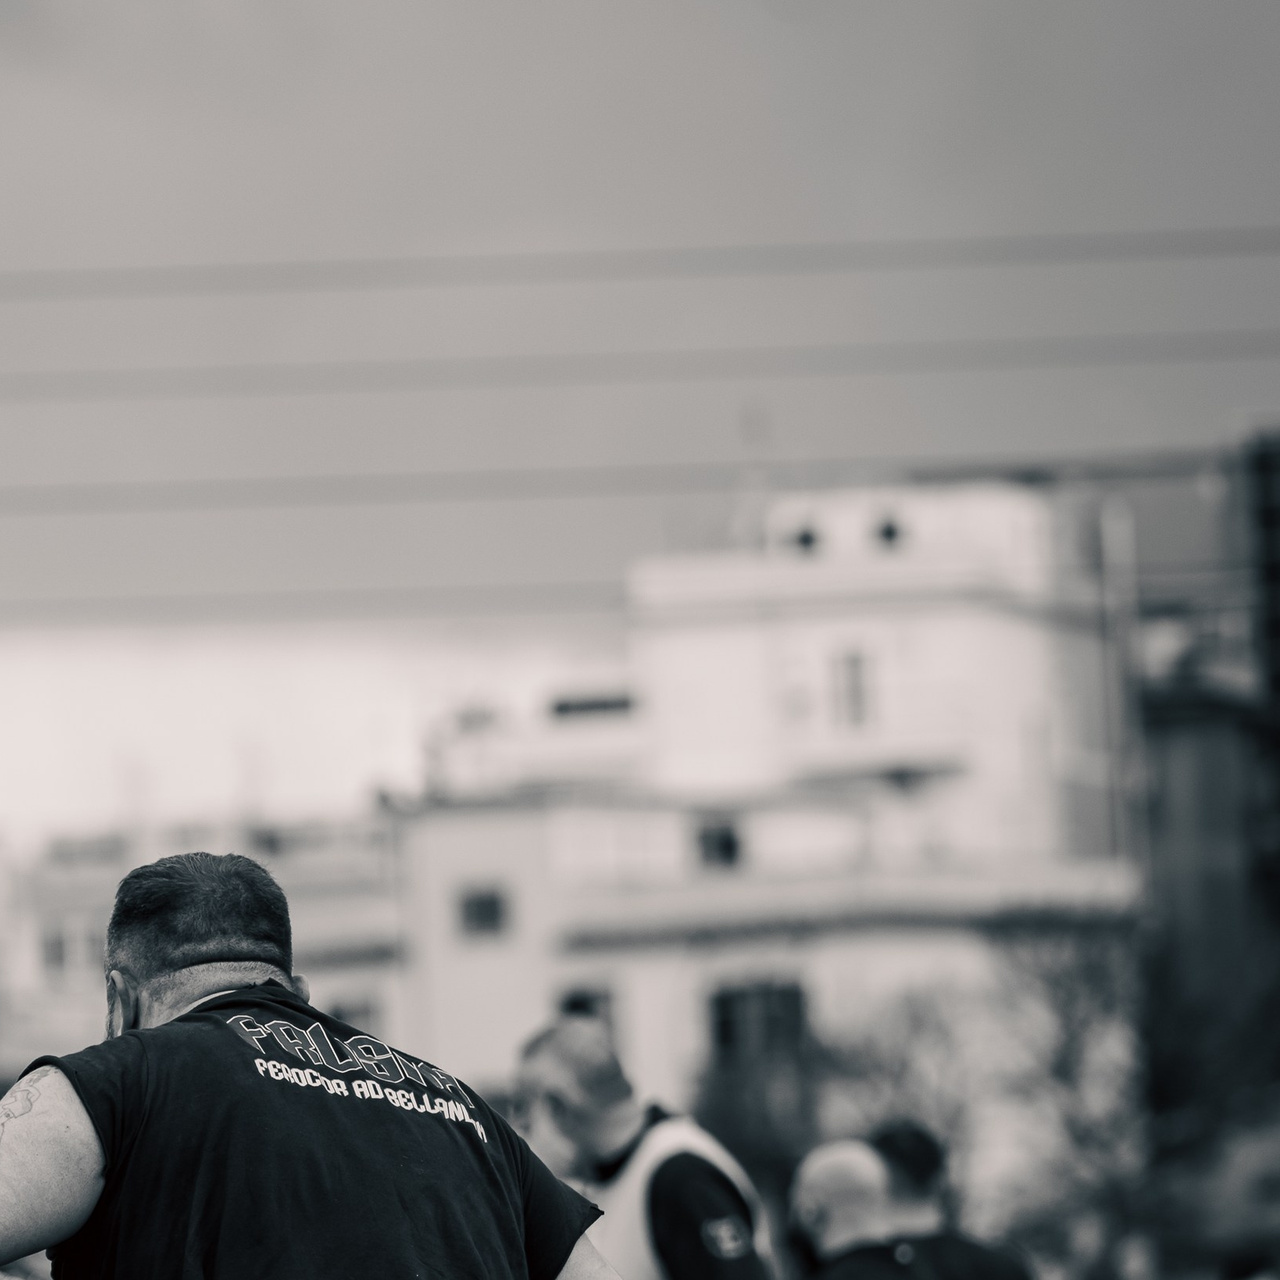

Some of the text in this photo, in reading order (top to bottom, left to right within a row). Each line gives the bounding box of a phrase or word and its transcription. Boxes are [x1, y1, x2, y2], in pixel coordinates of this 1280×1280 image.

[254, 1058, 487, 1143] FEROCOR AD BELLANM
